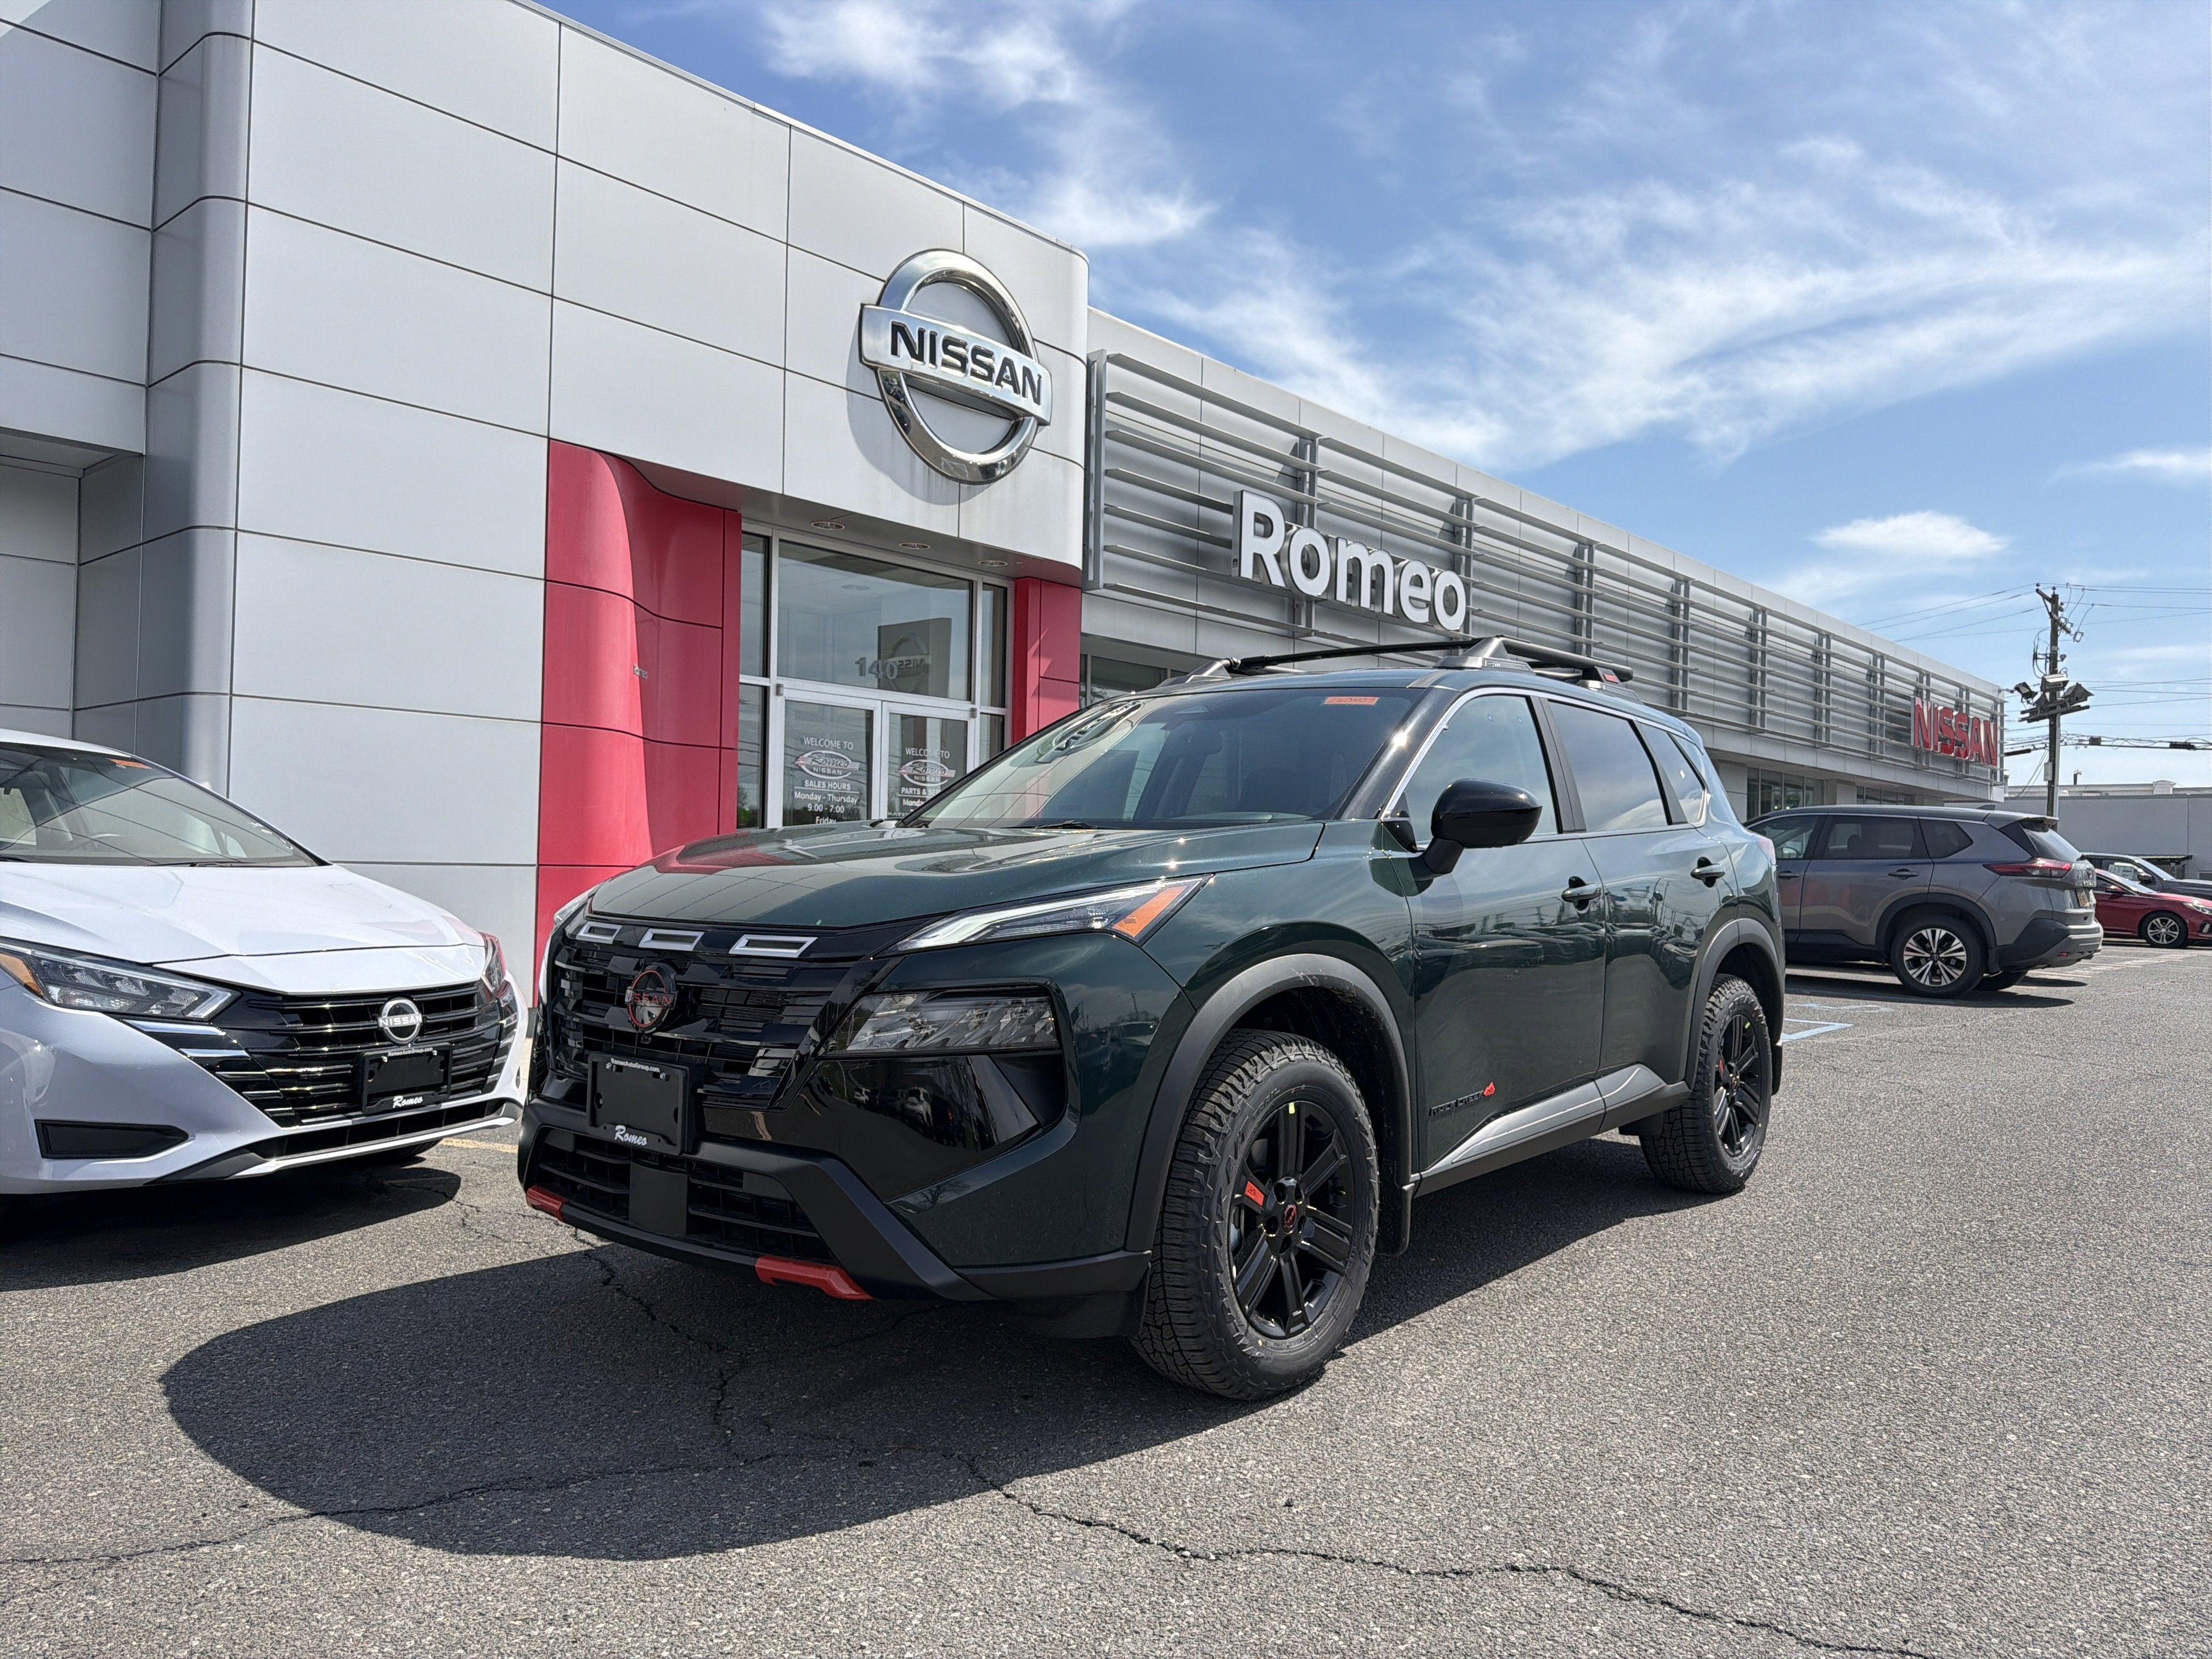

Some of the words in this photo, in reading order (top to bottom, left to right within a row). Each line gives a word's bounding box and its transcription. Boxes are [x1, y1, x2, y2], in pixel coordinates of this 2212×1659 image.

[890, 320, 1042, 408] NISSAN
[1238, 489, 1466, 631] Romeo
[855, 657, 898, 679] 140
[1912, 697, 1998, 768] NISSAN
[804, 736, 842, 749] WELCOME
[843, 741, 854, 750] TO
[807, 752, 850, 768] Romeo
[905, 747, 939, 757] WELCOME
[940, 750, 950, 759] TO
[813, 767, 843, 775] NISSAN
[804, 780, 826, 788] SALES
[828, 782, 851, 790] HOURS
[794, 791, 822, 802] Monday
[827, 793, 858, 805] Thursday
[808, 803, 823, 812] 9:00
[829, 805, 845, 813] 7:00
[625, 991, 673, 1006] NISSAN
[379, 1015, 422, 1027] NISSAN
[610, 1057, 661, 1073] RomeoAutoGroup.com
[392, 1095, 424, 1109] Romeo
[614, 1125, 648, 1147] Romeo
